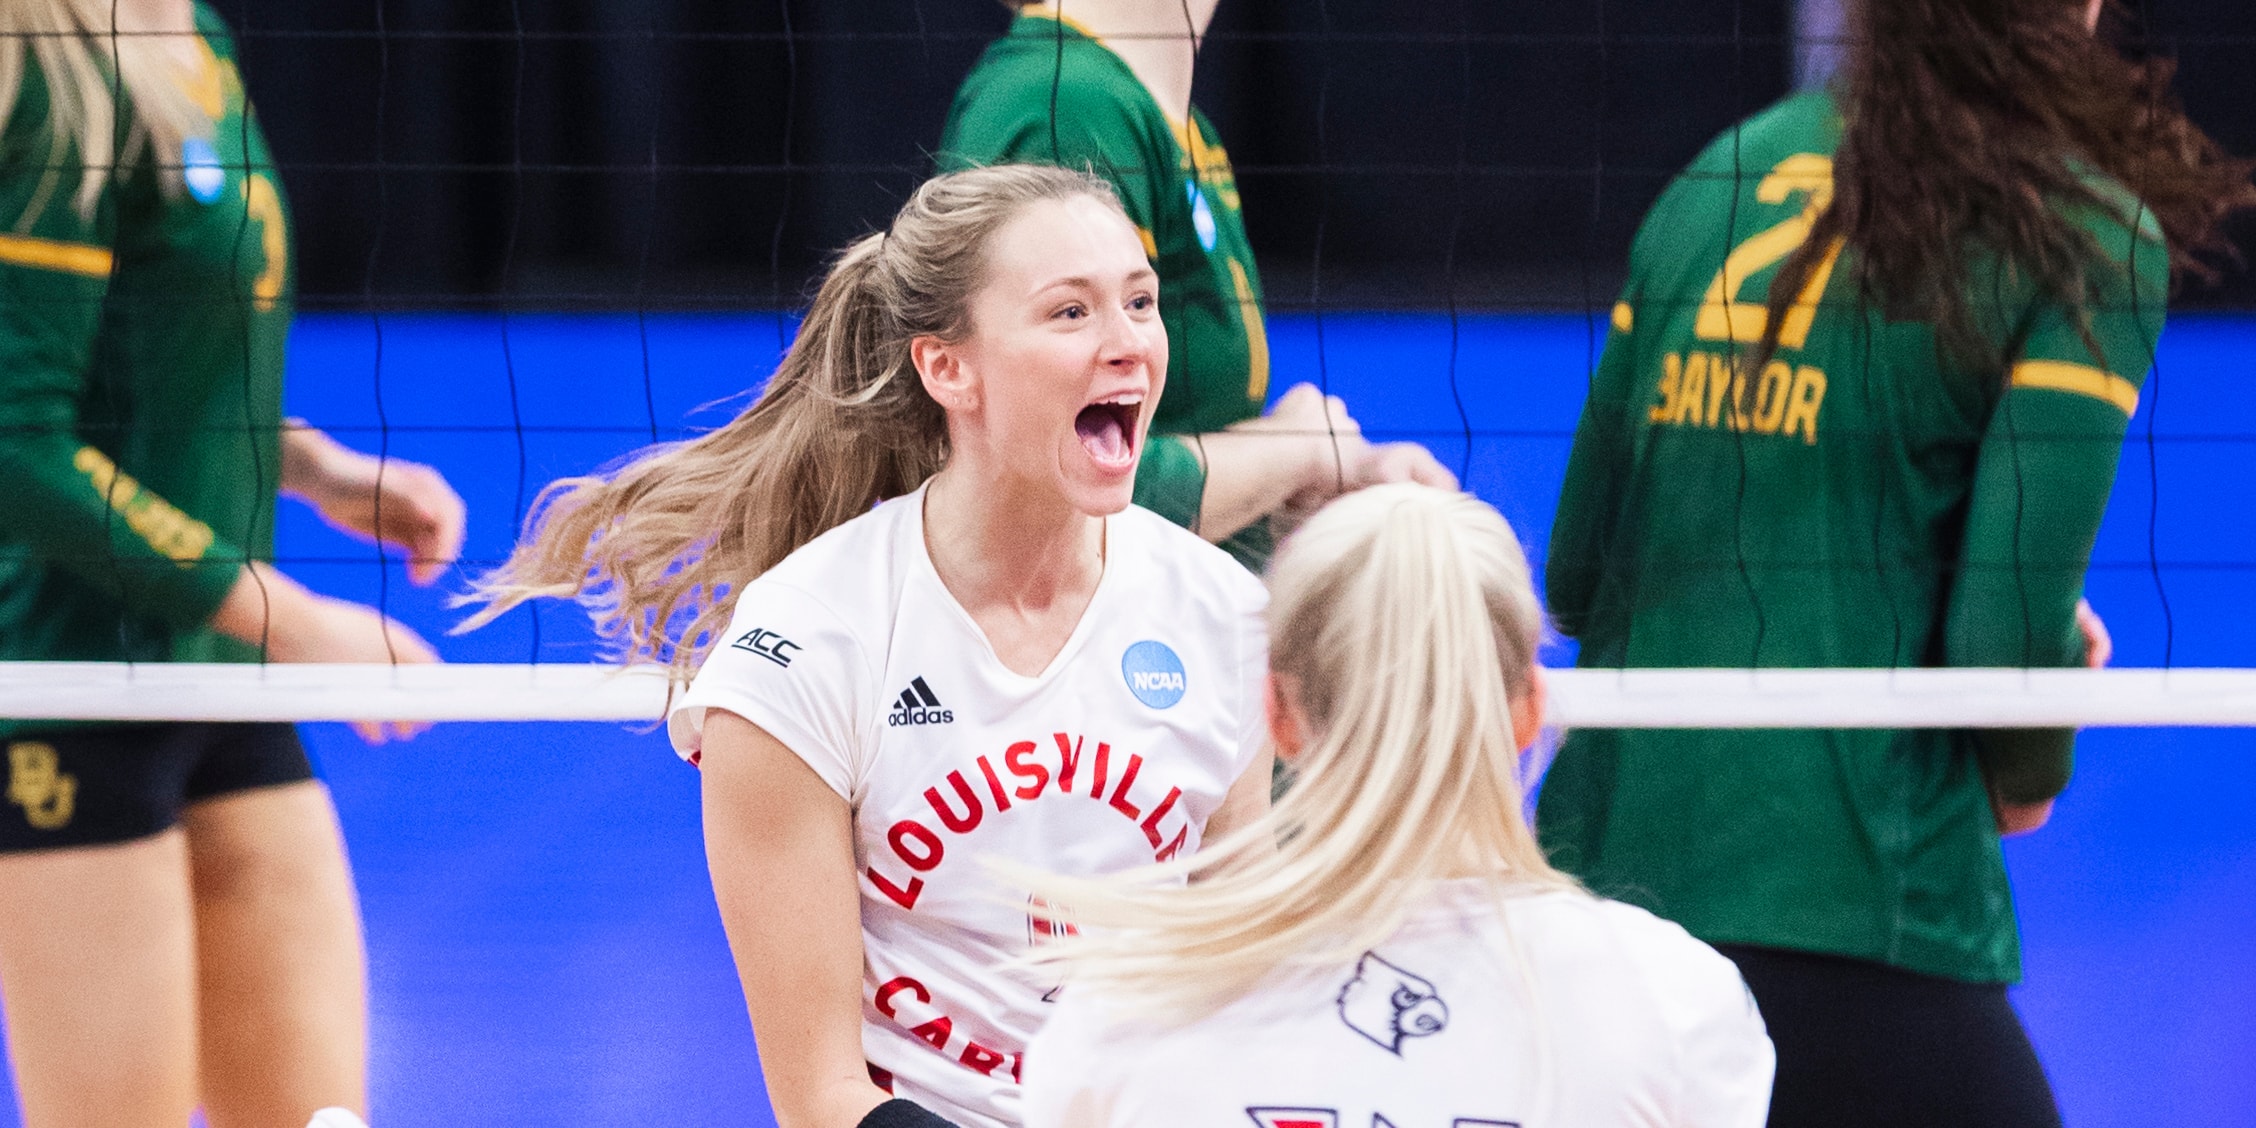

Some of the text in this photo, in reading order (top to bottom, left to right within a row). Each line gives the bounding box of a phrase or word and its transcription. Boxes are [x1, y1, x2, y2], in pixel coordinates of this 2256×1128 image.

[732, 627, 803, 668] ACC
[1132, 671, 1185, 691] NCAA
[889, 705, 953, 727] adidas
